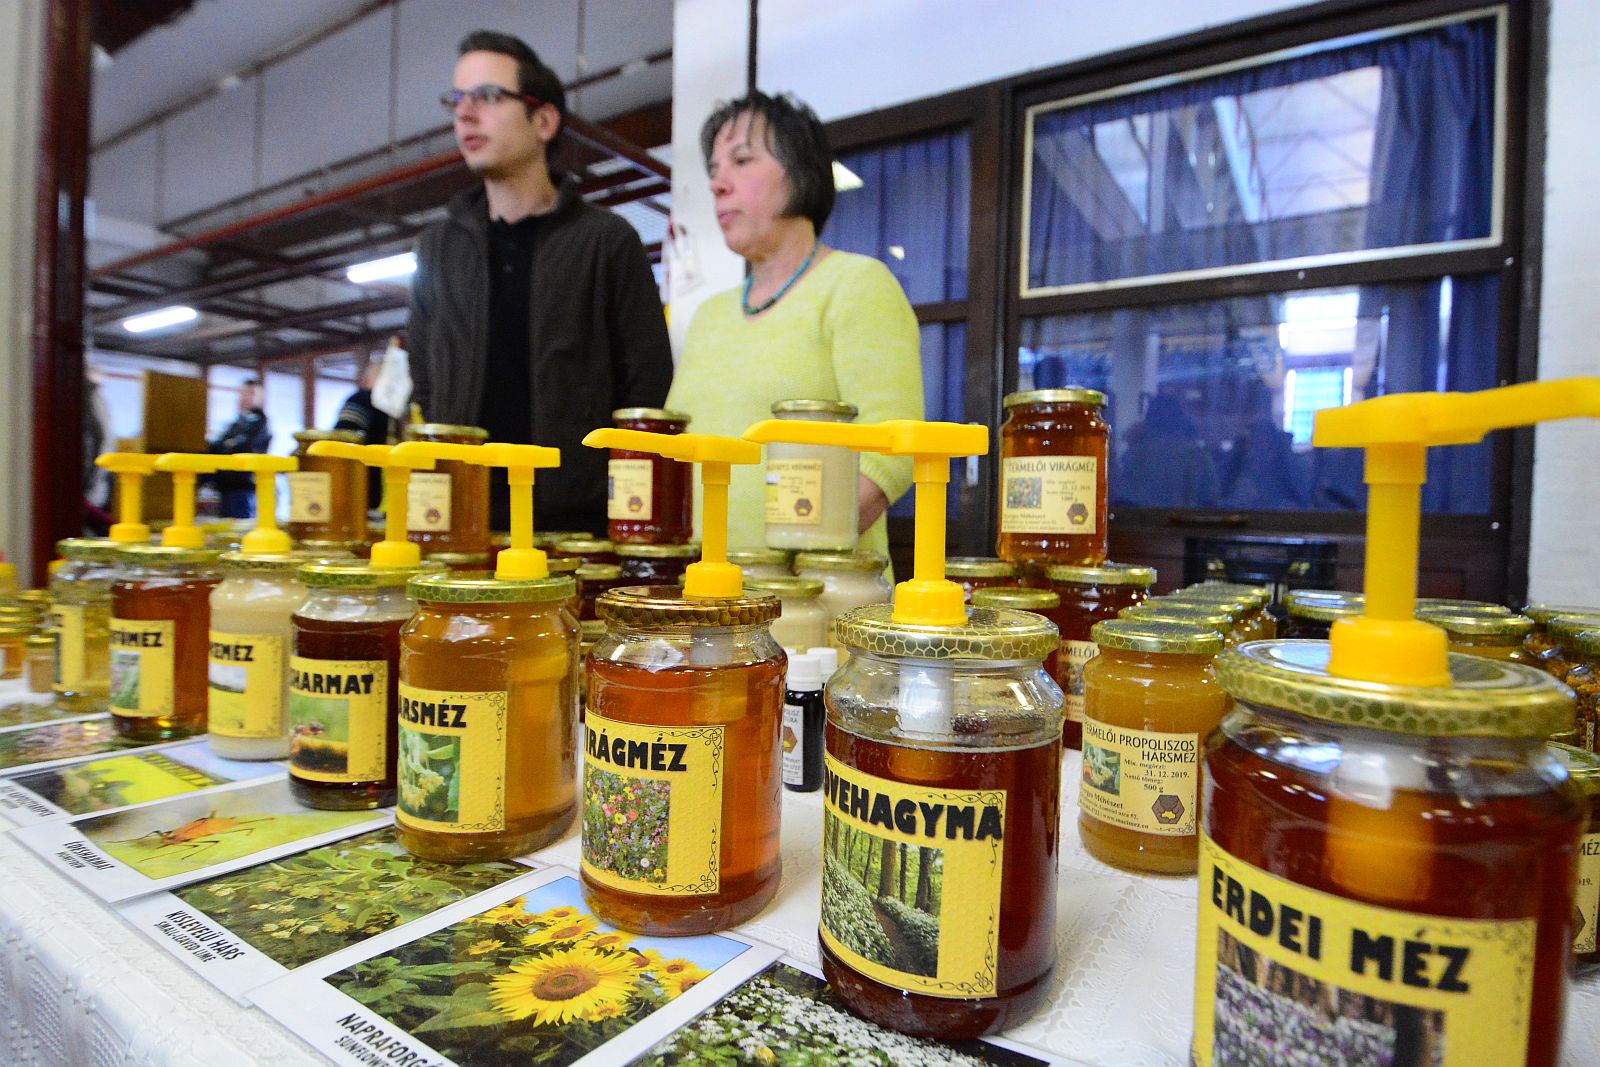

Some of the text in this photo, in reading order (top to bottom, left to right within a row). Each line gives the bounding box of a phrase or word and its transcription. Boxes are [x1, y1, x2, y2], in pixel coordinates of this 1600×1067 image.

[585, 725, 687, 771] IRÁGMÉZ
[1119, 734, 1195, 752] PROPOLISZOS
[1142, 749, 1196, 763] HÁRSMÉZ
[1145, 769, 1156, 777] 31.
[1158, 770, 1169, 778] 12.
[1144, 783, 1157, 791] 500
[1212, 864, 1469, 993] ERDEI MÉZ
[192, 947, 217, 963] LIME
[207, 938, 247, 961] HÁRS
